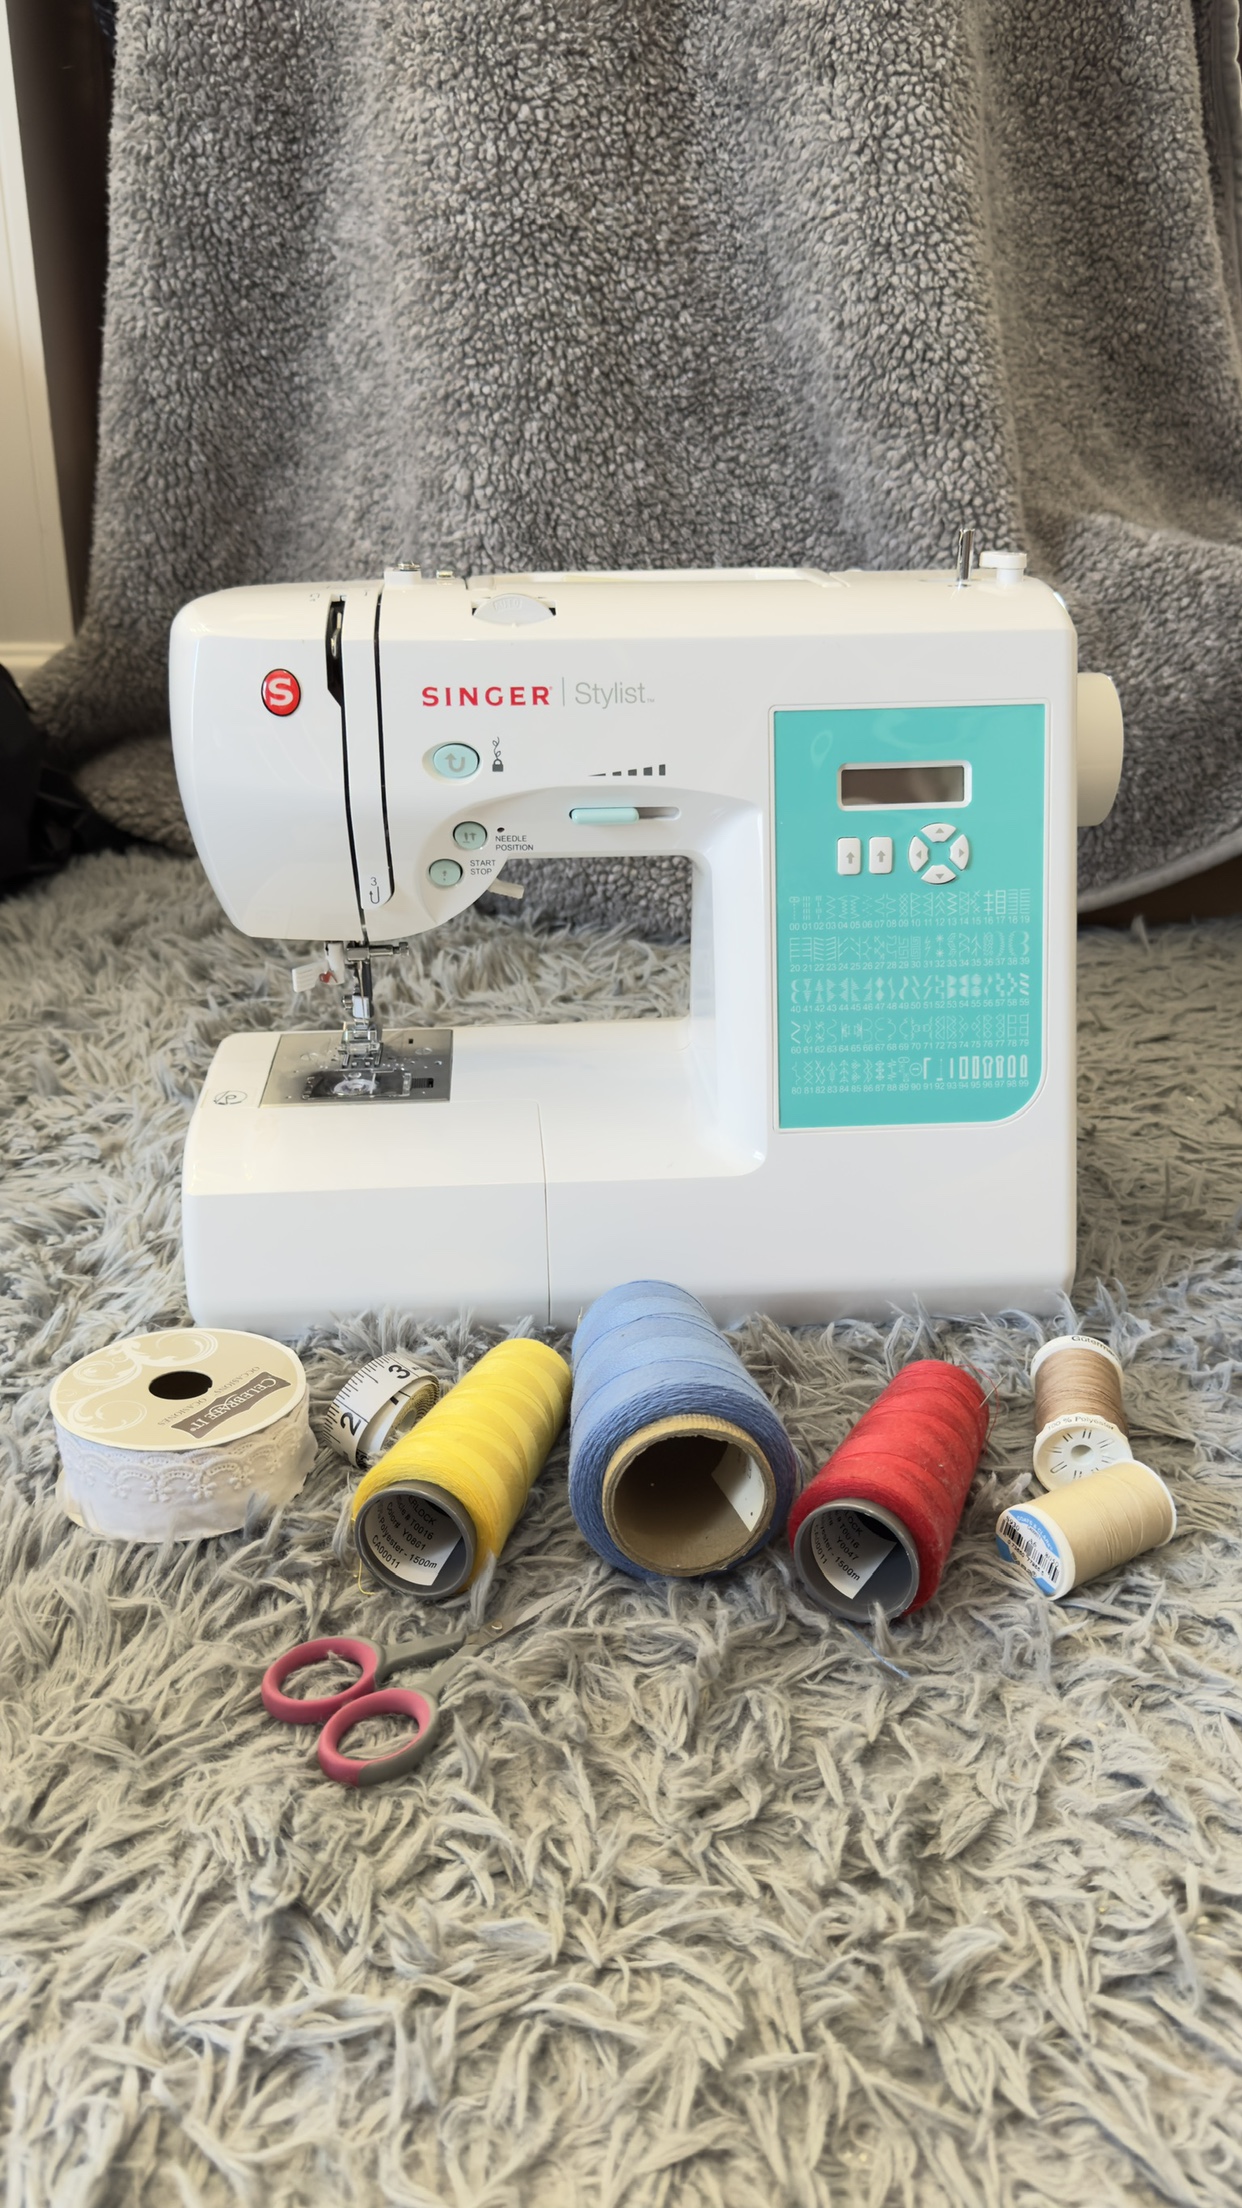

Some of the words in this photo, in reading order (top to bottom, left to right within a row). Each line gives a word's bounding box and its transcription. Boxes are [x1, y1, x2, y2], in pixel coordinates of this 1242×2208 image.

[269, 677, 293, 706] S
[421, 686, 550, 707] SINGER
[370, 877, 377, 886] 3
[789, 922, 799, 931] 00
[801, 922, 811, 931] 01
[813, 922, 824, 930] 02
[826, 921, 836, 930] 03
[838, 921, 848, 929] 04
[850, 921, 860, 929] 05
[862, 920, 872, 929] 06
[874, 920, 884, 928] 07
[886, 919, 897, 928] 08
[899, 919, 909, 928] 09
[911, 919, 921, 927] 10
[923, 918, 933, 927] 11
[935, 918, 945, 926] 12
[947, 917, 958, 926] 13
[960, 917, 970, 926] 14
[972, 917, 982, 925] 15
[984, 916, 994, 925] 16
[996, 916, 1006, 924] 17
[1008, 915, 1019, 924] 18
[1020, 915, 1031, 924] 19
[790, 964, 800, 972] 20
[802, 964, 813, 972] 21
[814, 963, 825, 972] 22
[827, 963, 837, 971] 23
[839, 963, 849, 971] 24
[851, 962, 861, 970] 25
[863, 962, 873, 970] 26
[875, 961, 885, 970] 27
[887, 961, 897, 969] 28
[899, 961, 909, 969] 29
[911, 960, 922, 968] 30
[924, 960, 934, 968] 31
[936, 959, 946, 968] 32
[948, 959, 958, 967] 33
[960, 959, 970, 967] 34
[972, 958, 982, 966] 35
[984, 958, 994, 966] 36
[996, 957, 1006, 966] 37
[1008, 957, 1019, 965] 38
[1020, 957, 1031, 965] 39
[790, 1005, 801, 1013] 40
[803, 1005, 813, 1013] 41
[827, 1004, 837, 1012] 43
[839, 1004, 849, 1012] 44
[863, 1003, 873, 1011] 46
[875, 1003, 885, 1011] 47
[887, 1002, 897, 1010] 48
[899, 1002, 909, 1010] 49
[911, 1002, 921, 1010] 50
[923, 1001, 933, 1009] 51
[935, 1001, 945, 1009] 52
[959, 1000, 969, 1008] 54
[971, 1000, 981, 1008] 55
[995, 999, 1006, 1007] 57
[1007, 999, 1018, 1007] 58
[1020, 998, 1030, 1006] 59
[803, 1046, 813, 1054] 61
[815, 1046, 825, 1054] 62
[839, 1045, 849, 1053] 64
[863, 1044, 873, 1052] 66
[875, 1044, 885, 1052] 67
[899, 1043, 909, 1051] 69
[911, 1043, 921, 1051] 70
[923, 1042, 933, 1050] 71
[935, 1042, 945, 1050] 72
[959, 1041, 969, 1049] 74
[971, 1041, 981, 1049] 75
[983, 1040, 993, 1048] 76
[995, 1040, 1005, 1048] 77
[1020, 1039, 1030, 1047] 79
[804, 1086, 813, 1094] 81
[816, 1086, 825, 1094] 82
[840, 1085, 849, 1093] 84
[852, 1085, 861, 1093] 85
[864, 1084, 873, 1092] 86
[876, 1084, 885, 1092] 87
[900, 1083, 909, 1091] 89
[912, 1083, 921, 1091] 90
[936, 1082, 945, 1090] 92
[948, 1082, 957, 1090] 93
[960, 1081, 969, 1089] 94
[972, 1081, 981, 1089] 95
[996, 1080, 1005, 1088] 97
[1008, 1080, 1017, 1088] 98
[388, 1364, 411, 1379] 3
[204, 1376, 277, 1420] CELEBRATE
[340, 1412, 361, 1436] 2
[1047, 1420, 1061, 1431] 100
[1075, 1416, 1114, 1430] Polyester
[410, 1518, 434, 1540] T0016
[372, 1534, 401, 1569] CA00011
[379, 1518, 404, 1554] Polyester
[409, 1554, 438, 1569] 1500m
[836, 1536, 860, 1561] Y0047
[835, 1556, 861, 1581] 1500m
